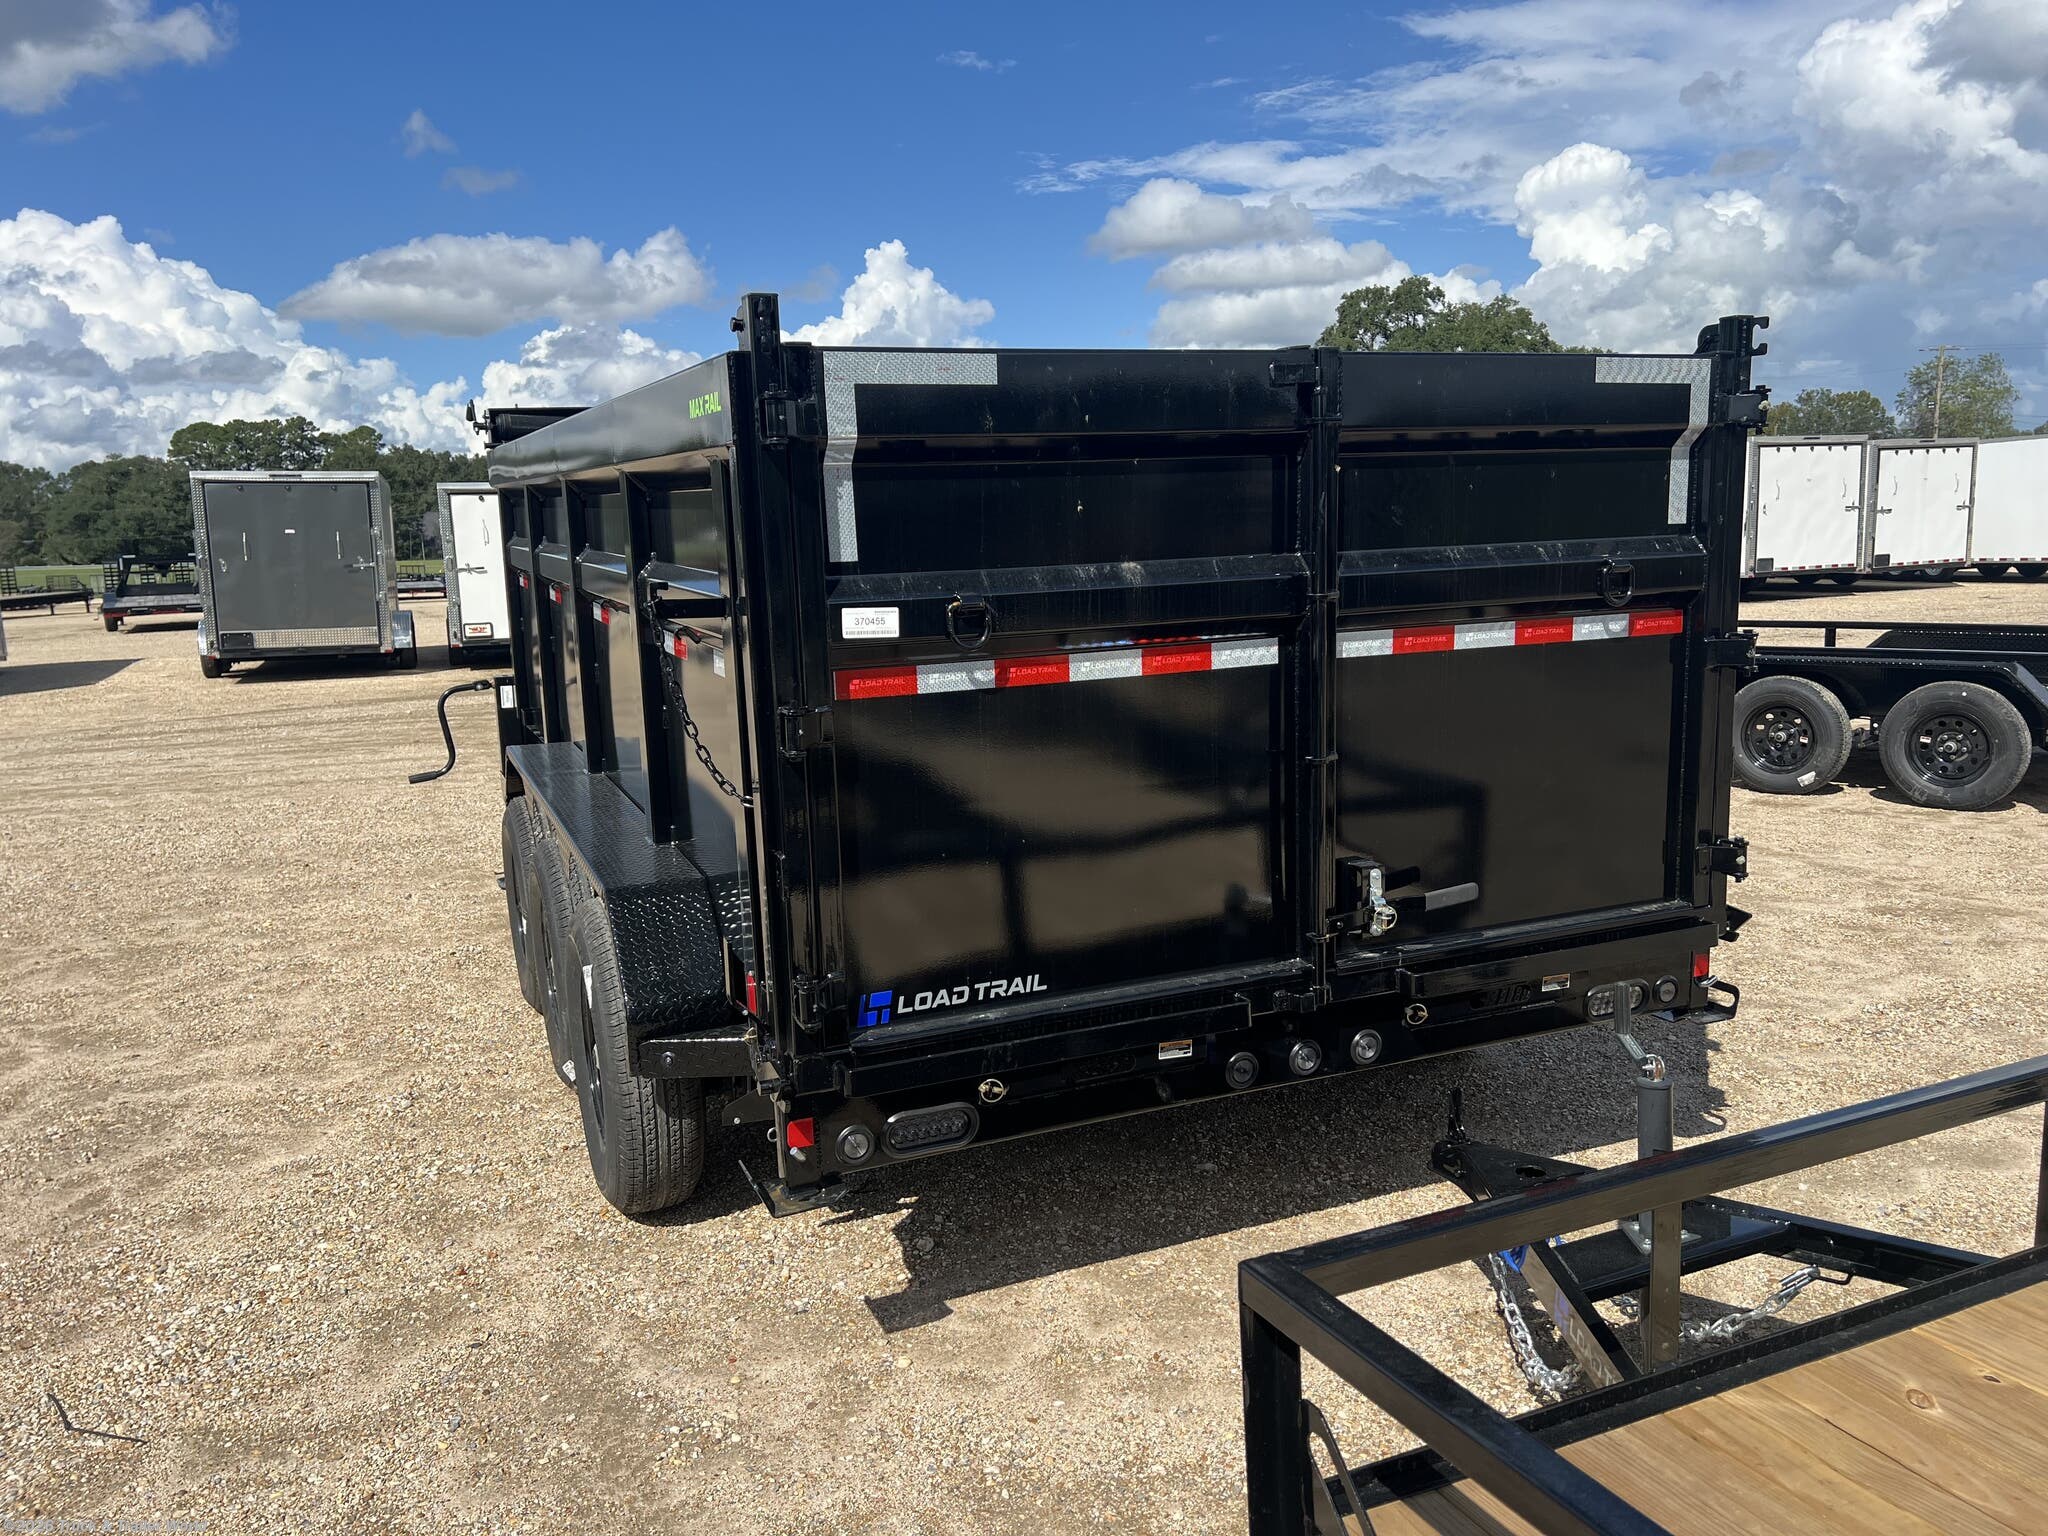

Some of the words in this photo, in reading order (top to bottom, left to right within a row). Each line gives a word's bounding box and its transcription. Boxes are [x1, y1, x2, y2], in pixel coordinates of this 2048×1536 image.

[689, 396, 704, 419] MAX
[704, 391, 722, 415] RAIL
[854, 617, 886, 626] 370455
[1017, 667, 1039, 676] LOAD
[860, 678, 882, 687] LOAD
[882, 676, 906, 686] TRAIL
[897, 985, 970, 1014] LOAD
[974, 974, 1048, 1001] TRAIL
